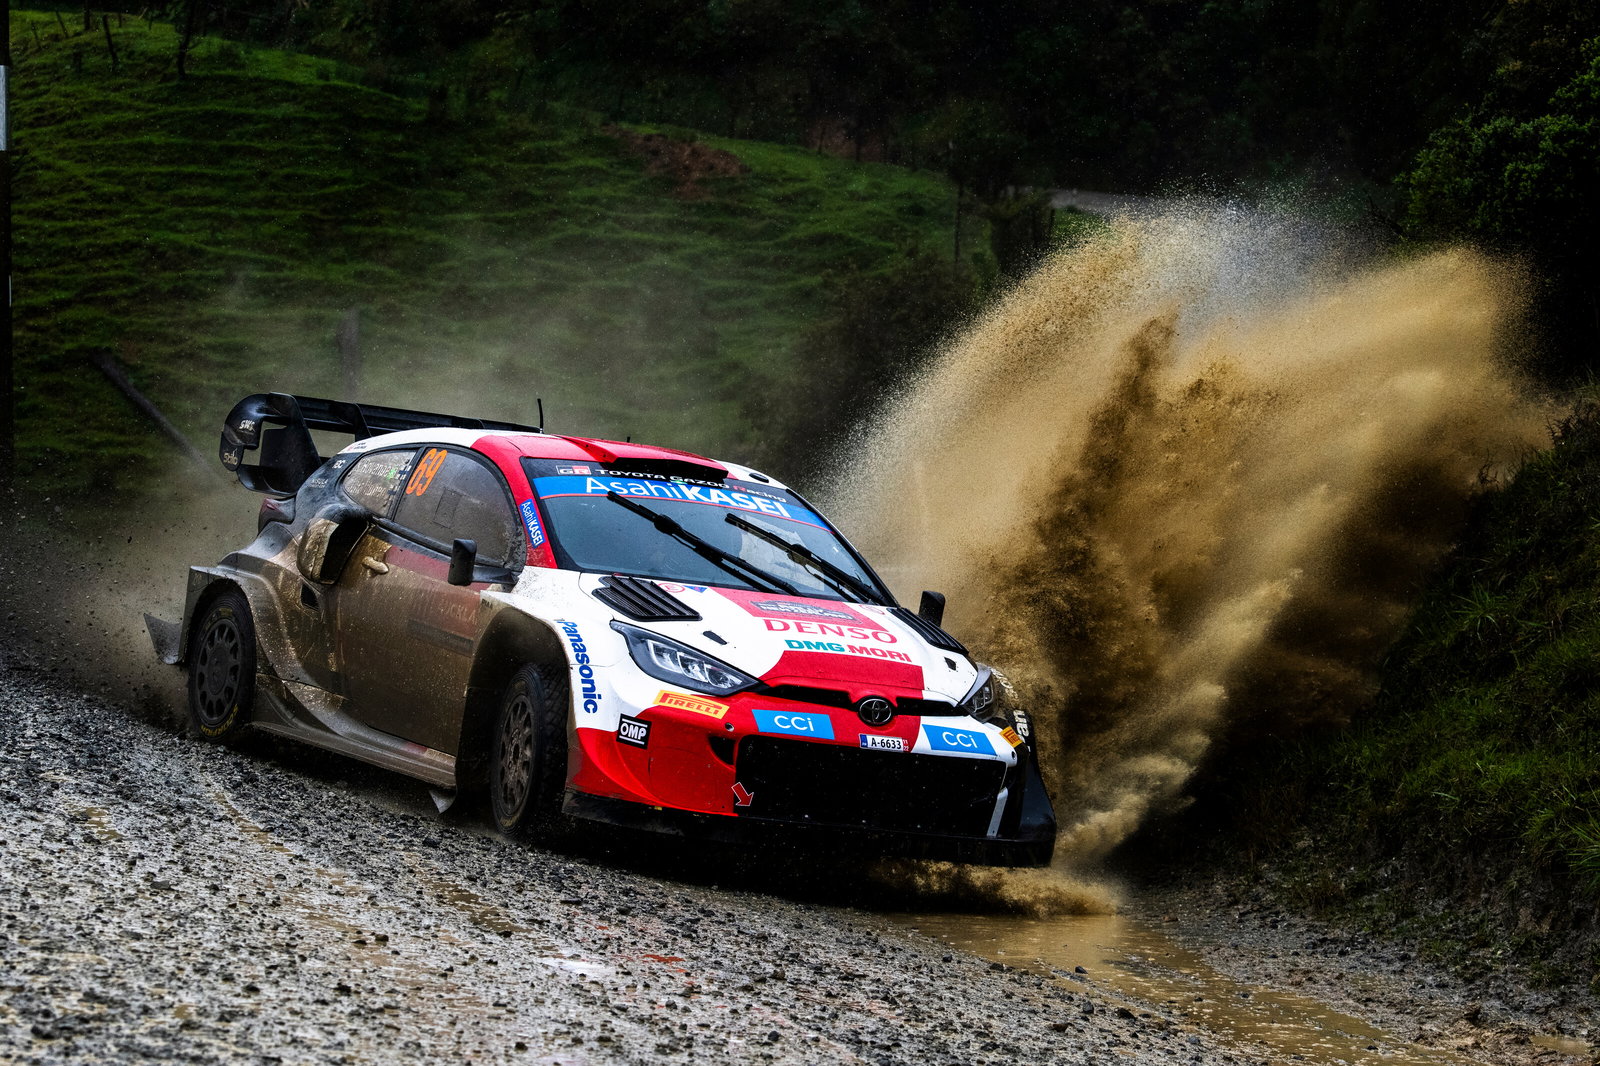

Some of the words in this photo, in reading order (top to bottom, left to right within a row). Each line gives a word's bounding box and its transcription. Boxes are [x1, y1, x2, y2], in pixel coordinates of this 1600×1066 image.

[405, 448, 448, 497] 69
[596, 469, 665, 481] TOYOTA
[733, 485, 787, 503] Racing
[762, 618, 898, 644] DENSO
[784, 639, 846, 653] DMG
[847, 644, 913, 663] MORI
[658, 692, 723, 716] PIRELLI
[620, 723, 647, 740] OMP
[871, 737, 902, 750] A-6633
